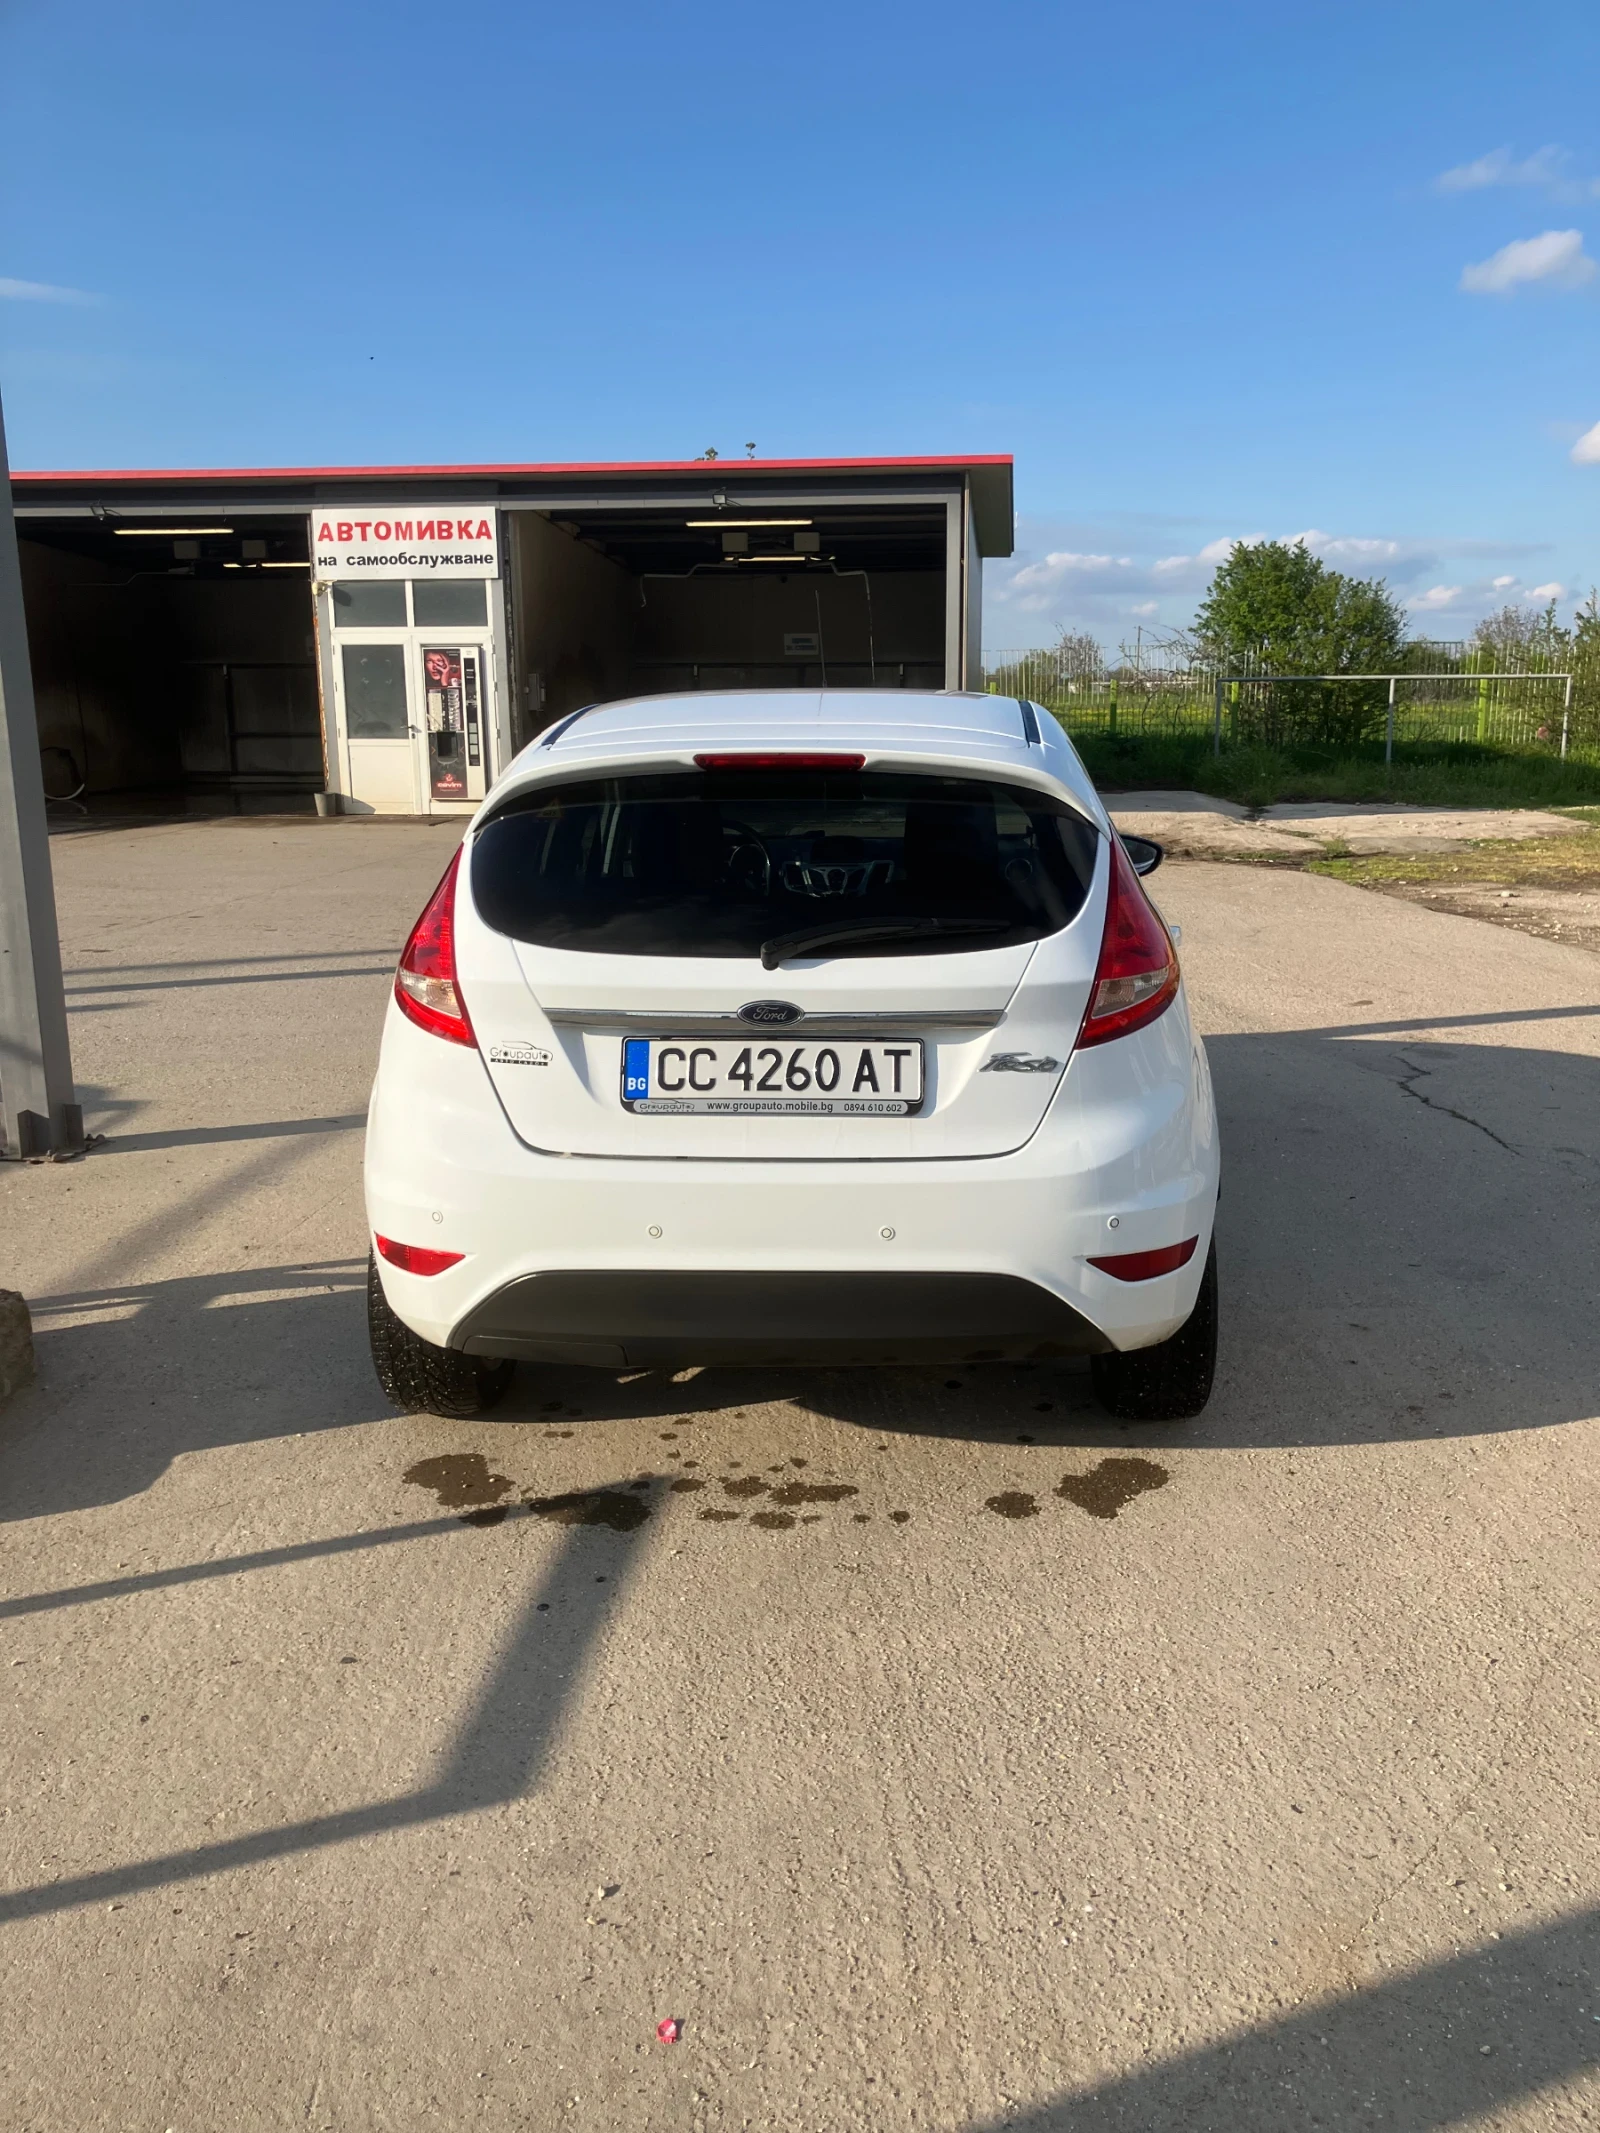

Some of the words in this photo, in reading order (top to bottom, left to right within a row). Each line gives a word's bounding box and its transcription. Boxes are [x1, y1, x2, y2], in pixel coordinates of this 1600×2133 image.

[317, 519, 493, 542] АВТОМИВКА
[317, 556, 337, 566] на
[346, 552, 494, 568] самообслужване
[752, 1006, 788, 1020] Ford
[657, 1047, 717, 1091] CC
[727, 1047, 840, 1092] 4260
[851, 1048, 912, 1093] AT
[627, 1077, 646, 1091] BG
[706, 1101, 833, 1113] www.groupauto.mobile.bg
[843, 1103, 865, 1112] 0894
[867, 1103, 884, 1112] 610
[885, 1104, 902, 1112] 602
